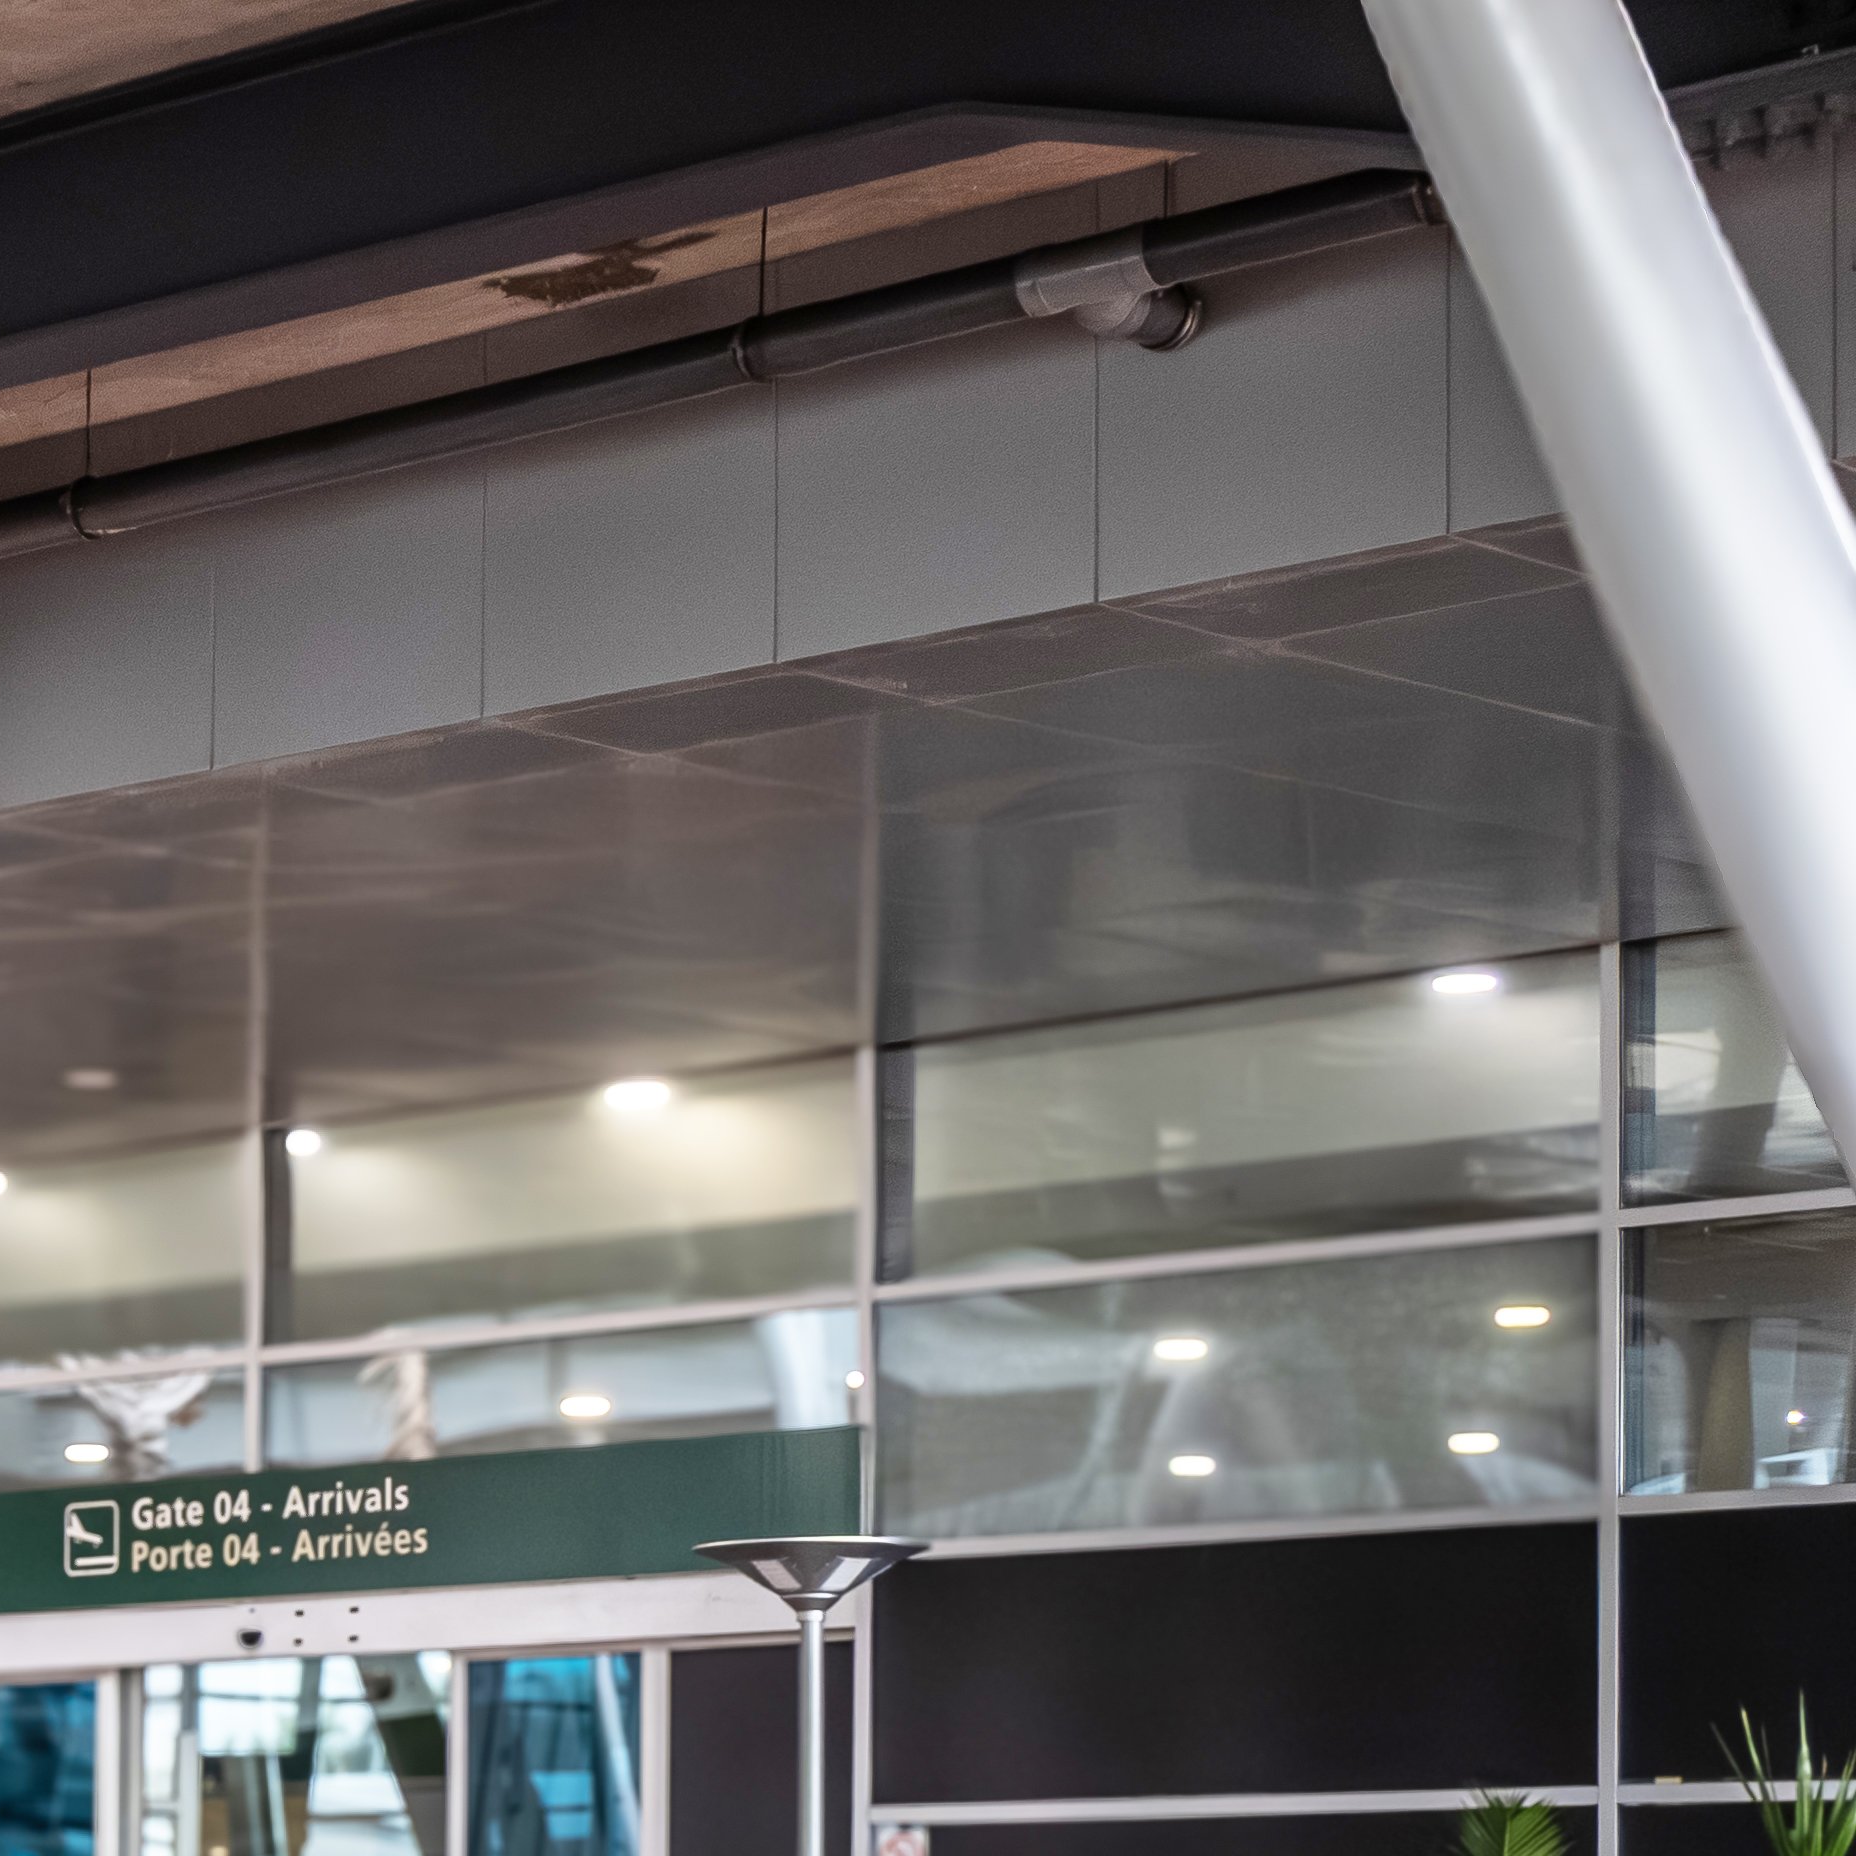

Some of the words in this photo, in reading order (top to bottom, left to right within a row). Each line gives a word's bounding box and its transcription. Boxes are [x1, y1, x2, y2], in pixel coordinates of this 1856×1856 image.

[131, 1497, 204, 1530] Gate
[213, 1489, 252, 1524] 04
[282, 1476, 410, 1519] Arrivals
[131, 1540, 213, 1573] Porte
[222, 1532, 261, 1567] 04
[291, 1521, 429, 1563] Arrivées
